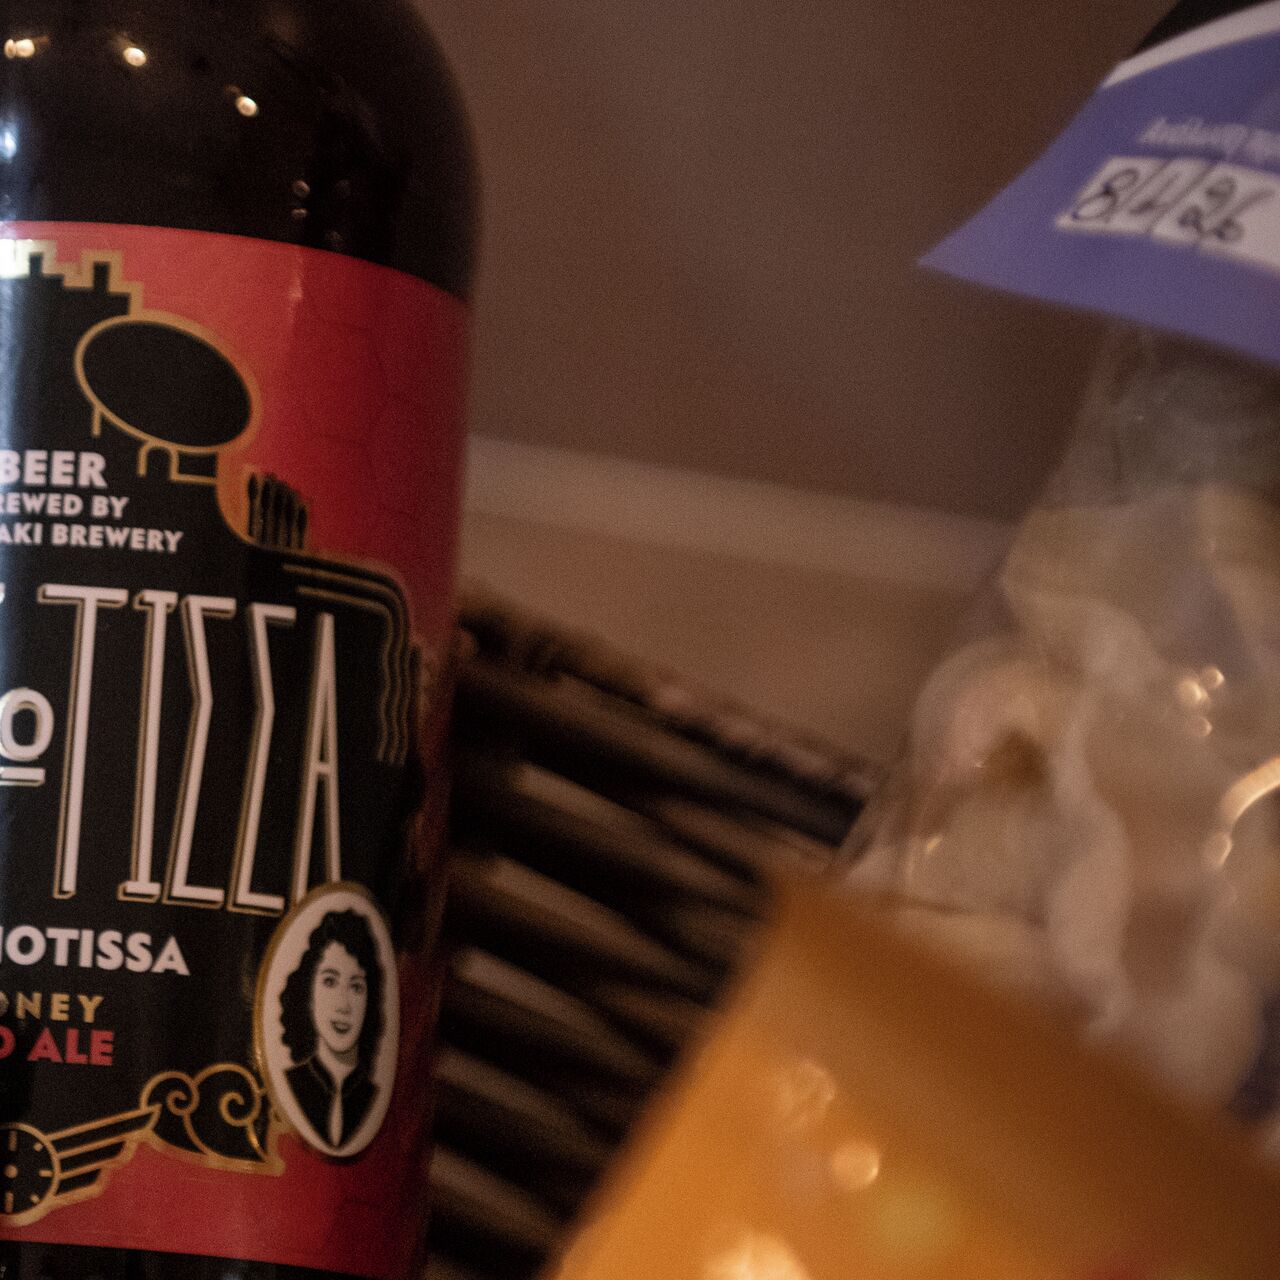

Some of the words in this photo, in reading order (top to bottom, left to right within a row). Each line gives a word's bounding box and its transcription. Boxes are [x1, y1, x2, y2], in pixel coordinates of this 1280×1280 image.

[91, 495, 130, 520] BY
[50, 523, 185, 554] BREWERY
[26, 1025, 116, 1067] ALE
